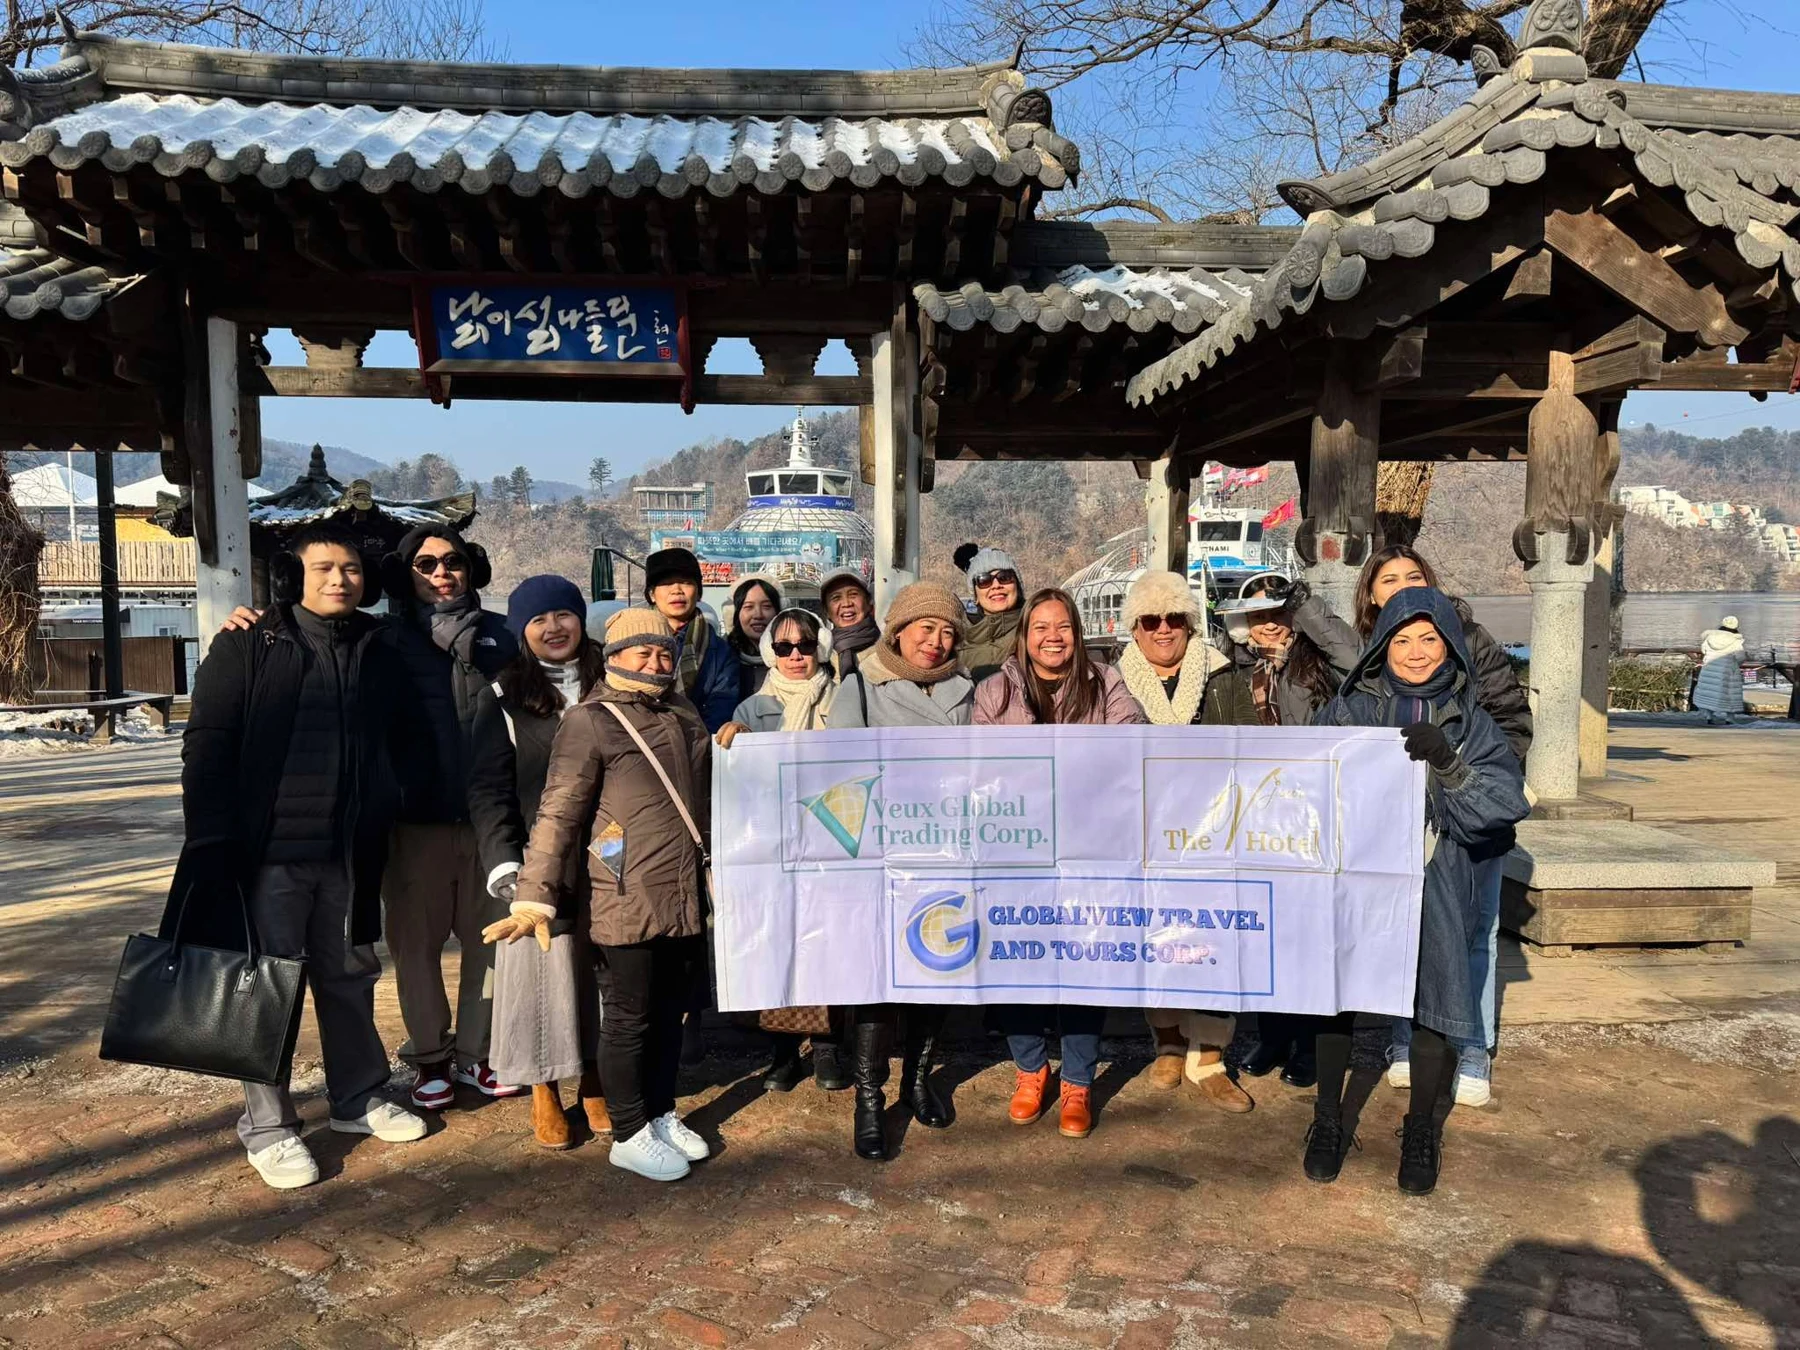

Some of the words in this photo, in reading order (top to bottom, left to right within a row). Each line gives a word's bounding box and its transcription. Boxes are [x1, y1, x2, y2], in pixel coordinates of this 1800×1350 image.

[871, 798, 935, 818] Veux
[940, 795, 1026, 818] Global
[872, 823, 973, 850] Trading
[979, 823, 1049, 850] Corp.
[1163, 828, 1212, 851] The
[1245, 829, 1320, 853] Hotel
[1158, 907, 1265, 931] TRAVEL
[989, 940, 1046, 960] AND
[1053, 940, 1137, 963] TOURS
[1141, 941, 1217, 965] CORP.
